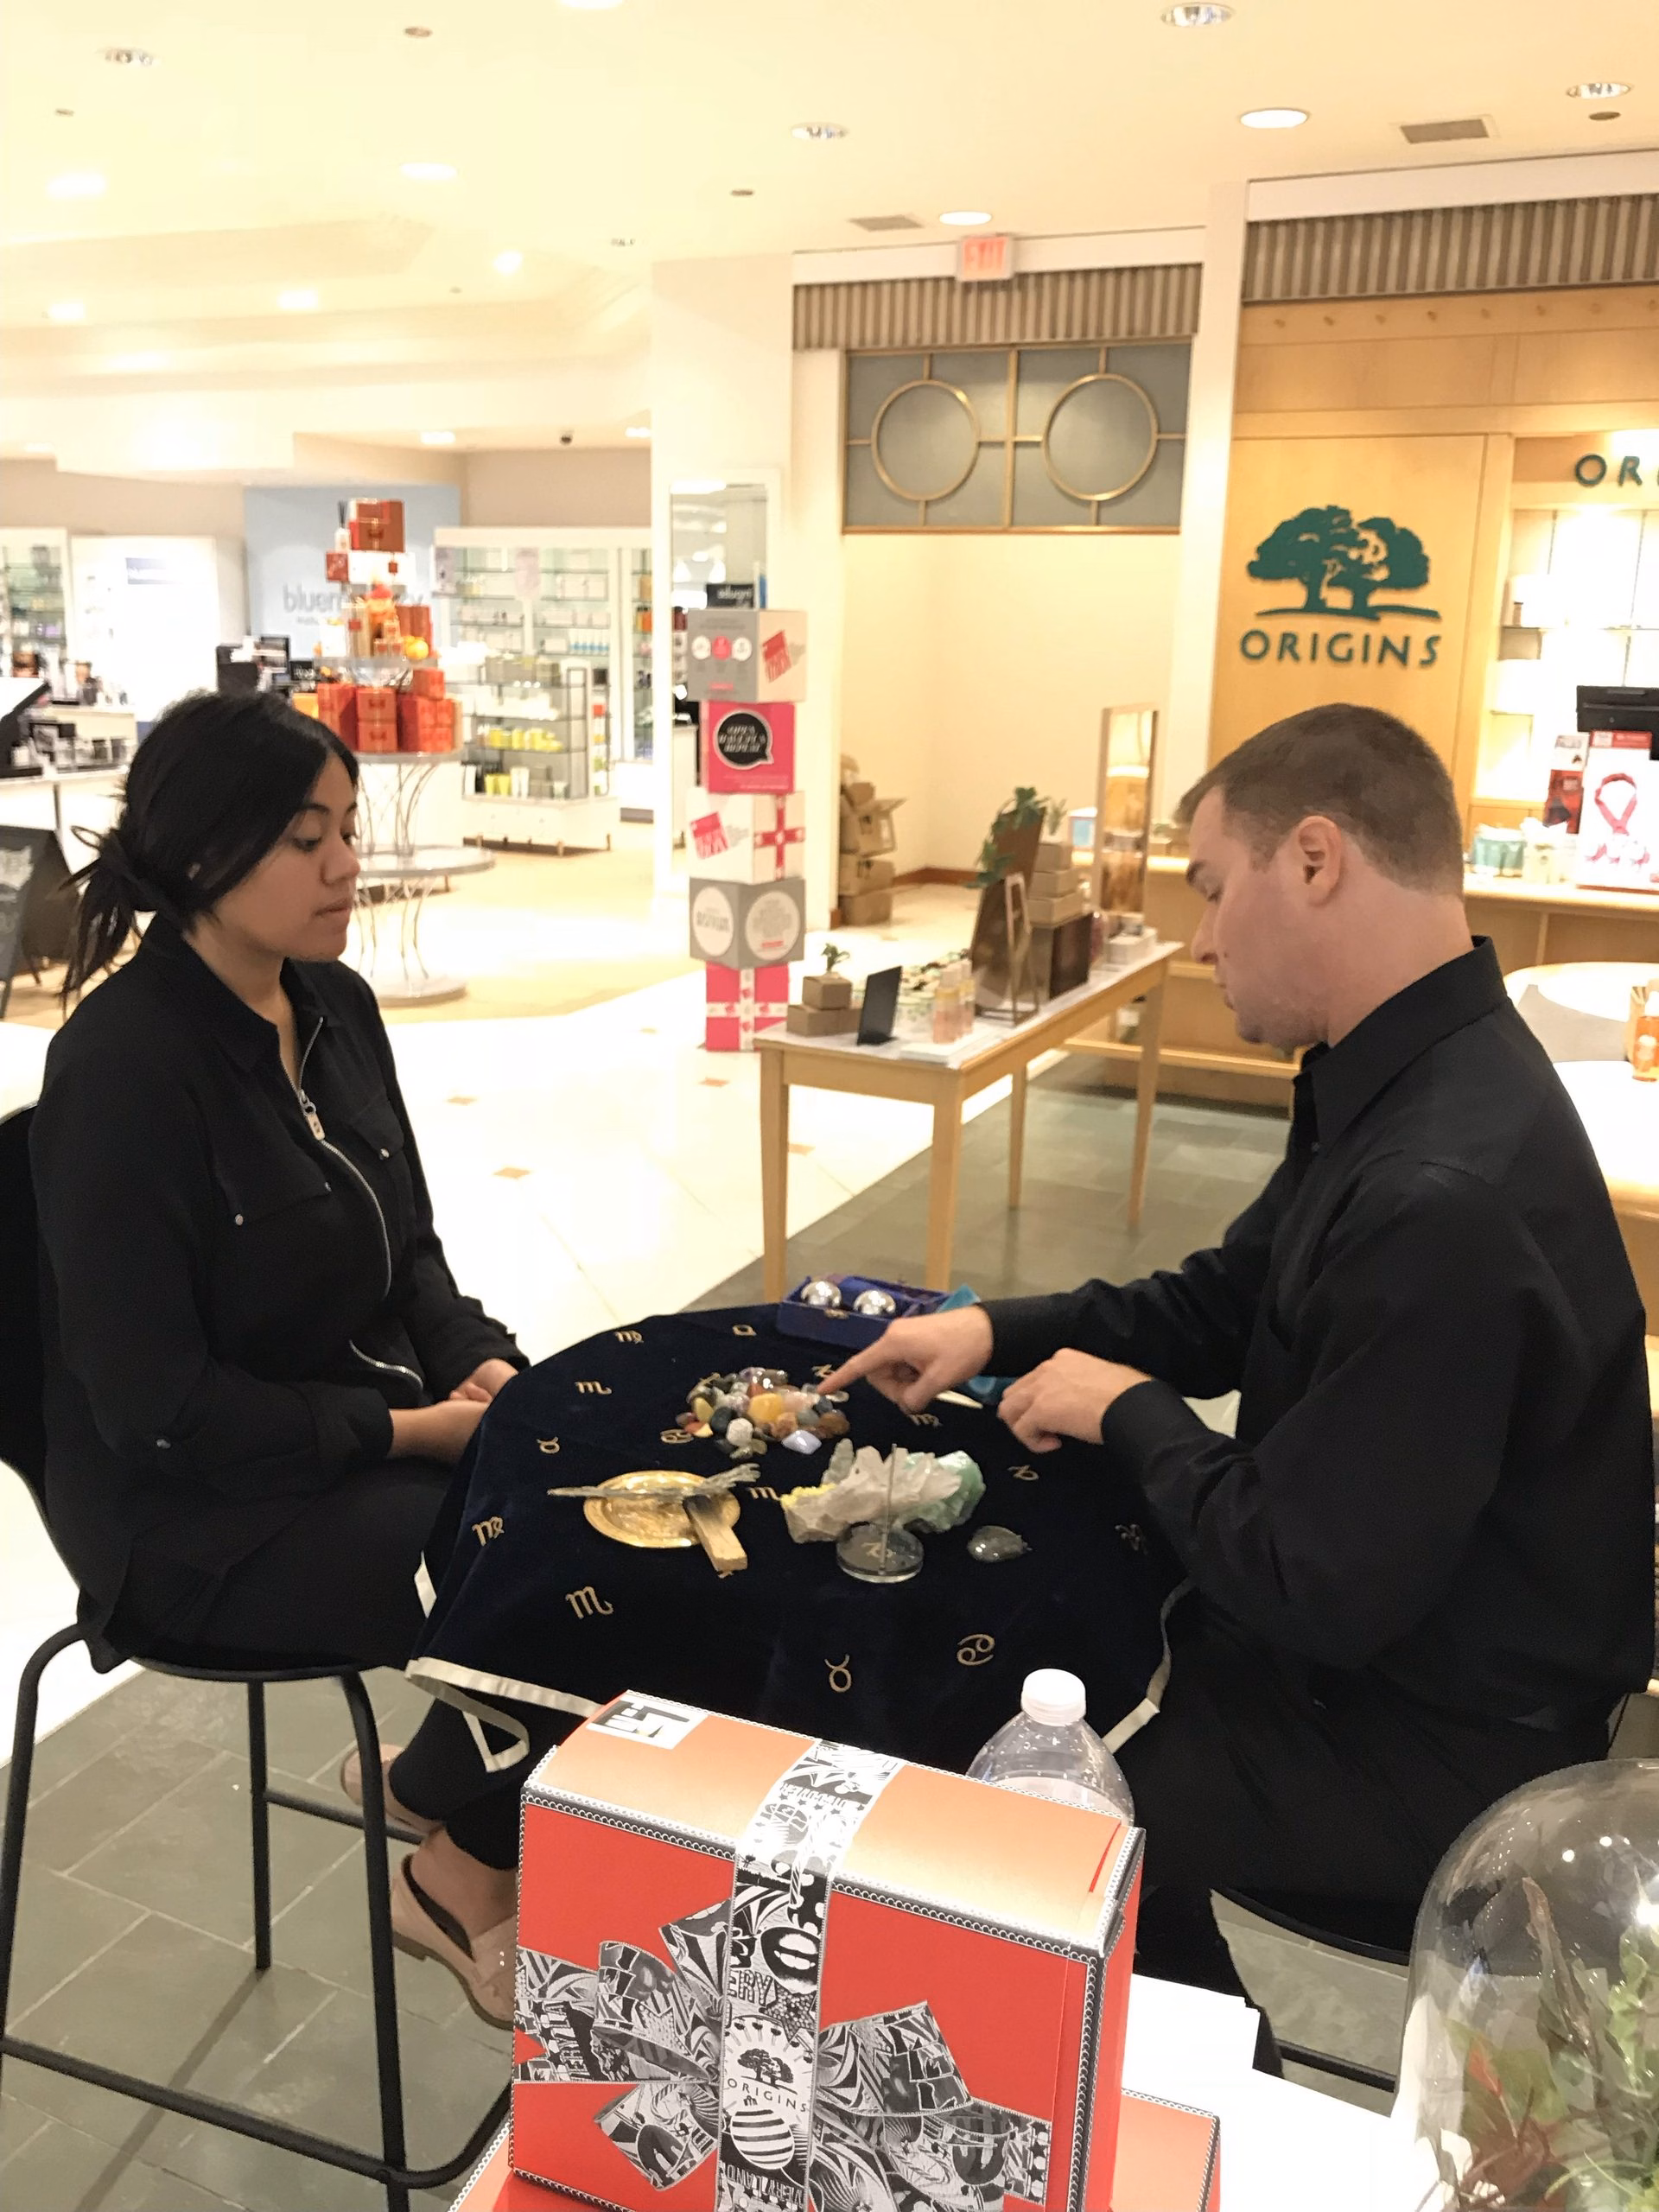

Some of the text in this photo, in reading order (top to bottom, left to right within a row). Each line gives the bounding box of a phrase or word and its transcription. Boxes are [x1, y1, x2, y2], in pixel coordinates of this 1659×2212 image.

[1574, 454, 1659, 487] OR
[1240, 629, 1441, 668] ORIGINS
[727, 2077, 807, 2113] ORIGINS
